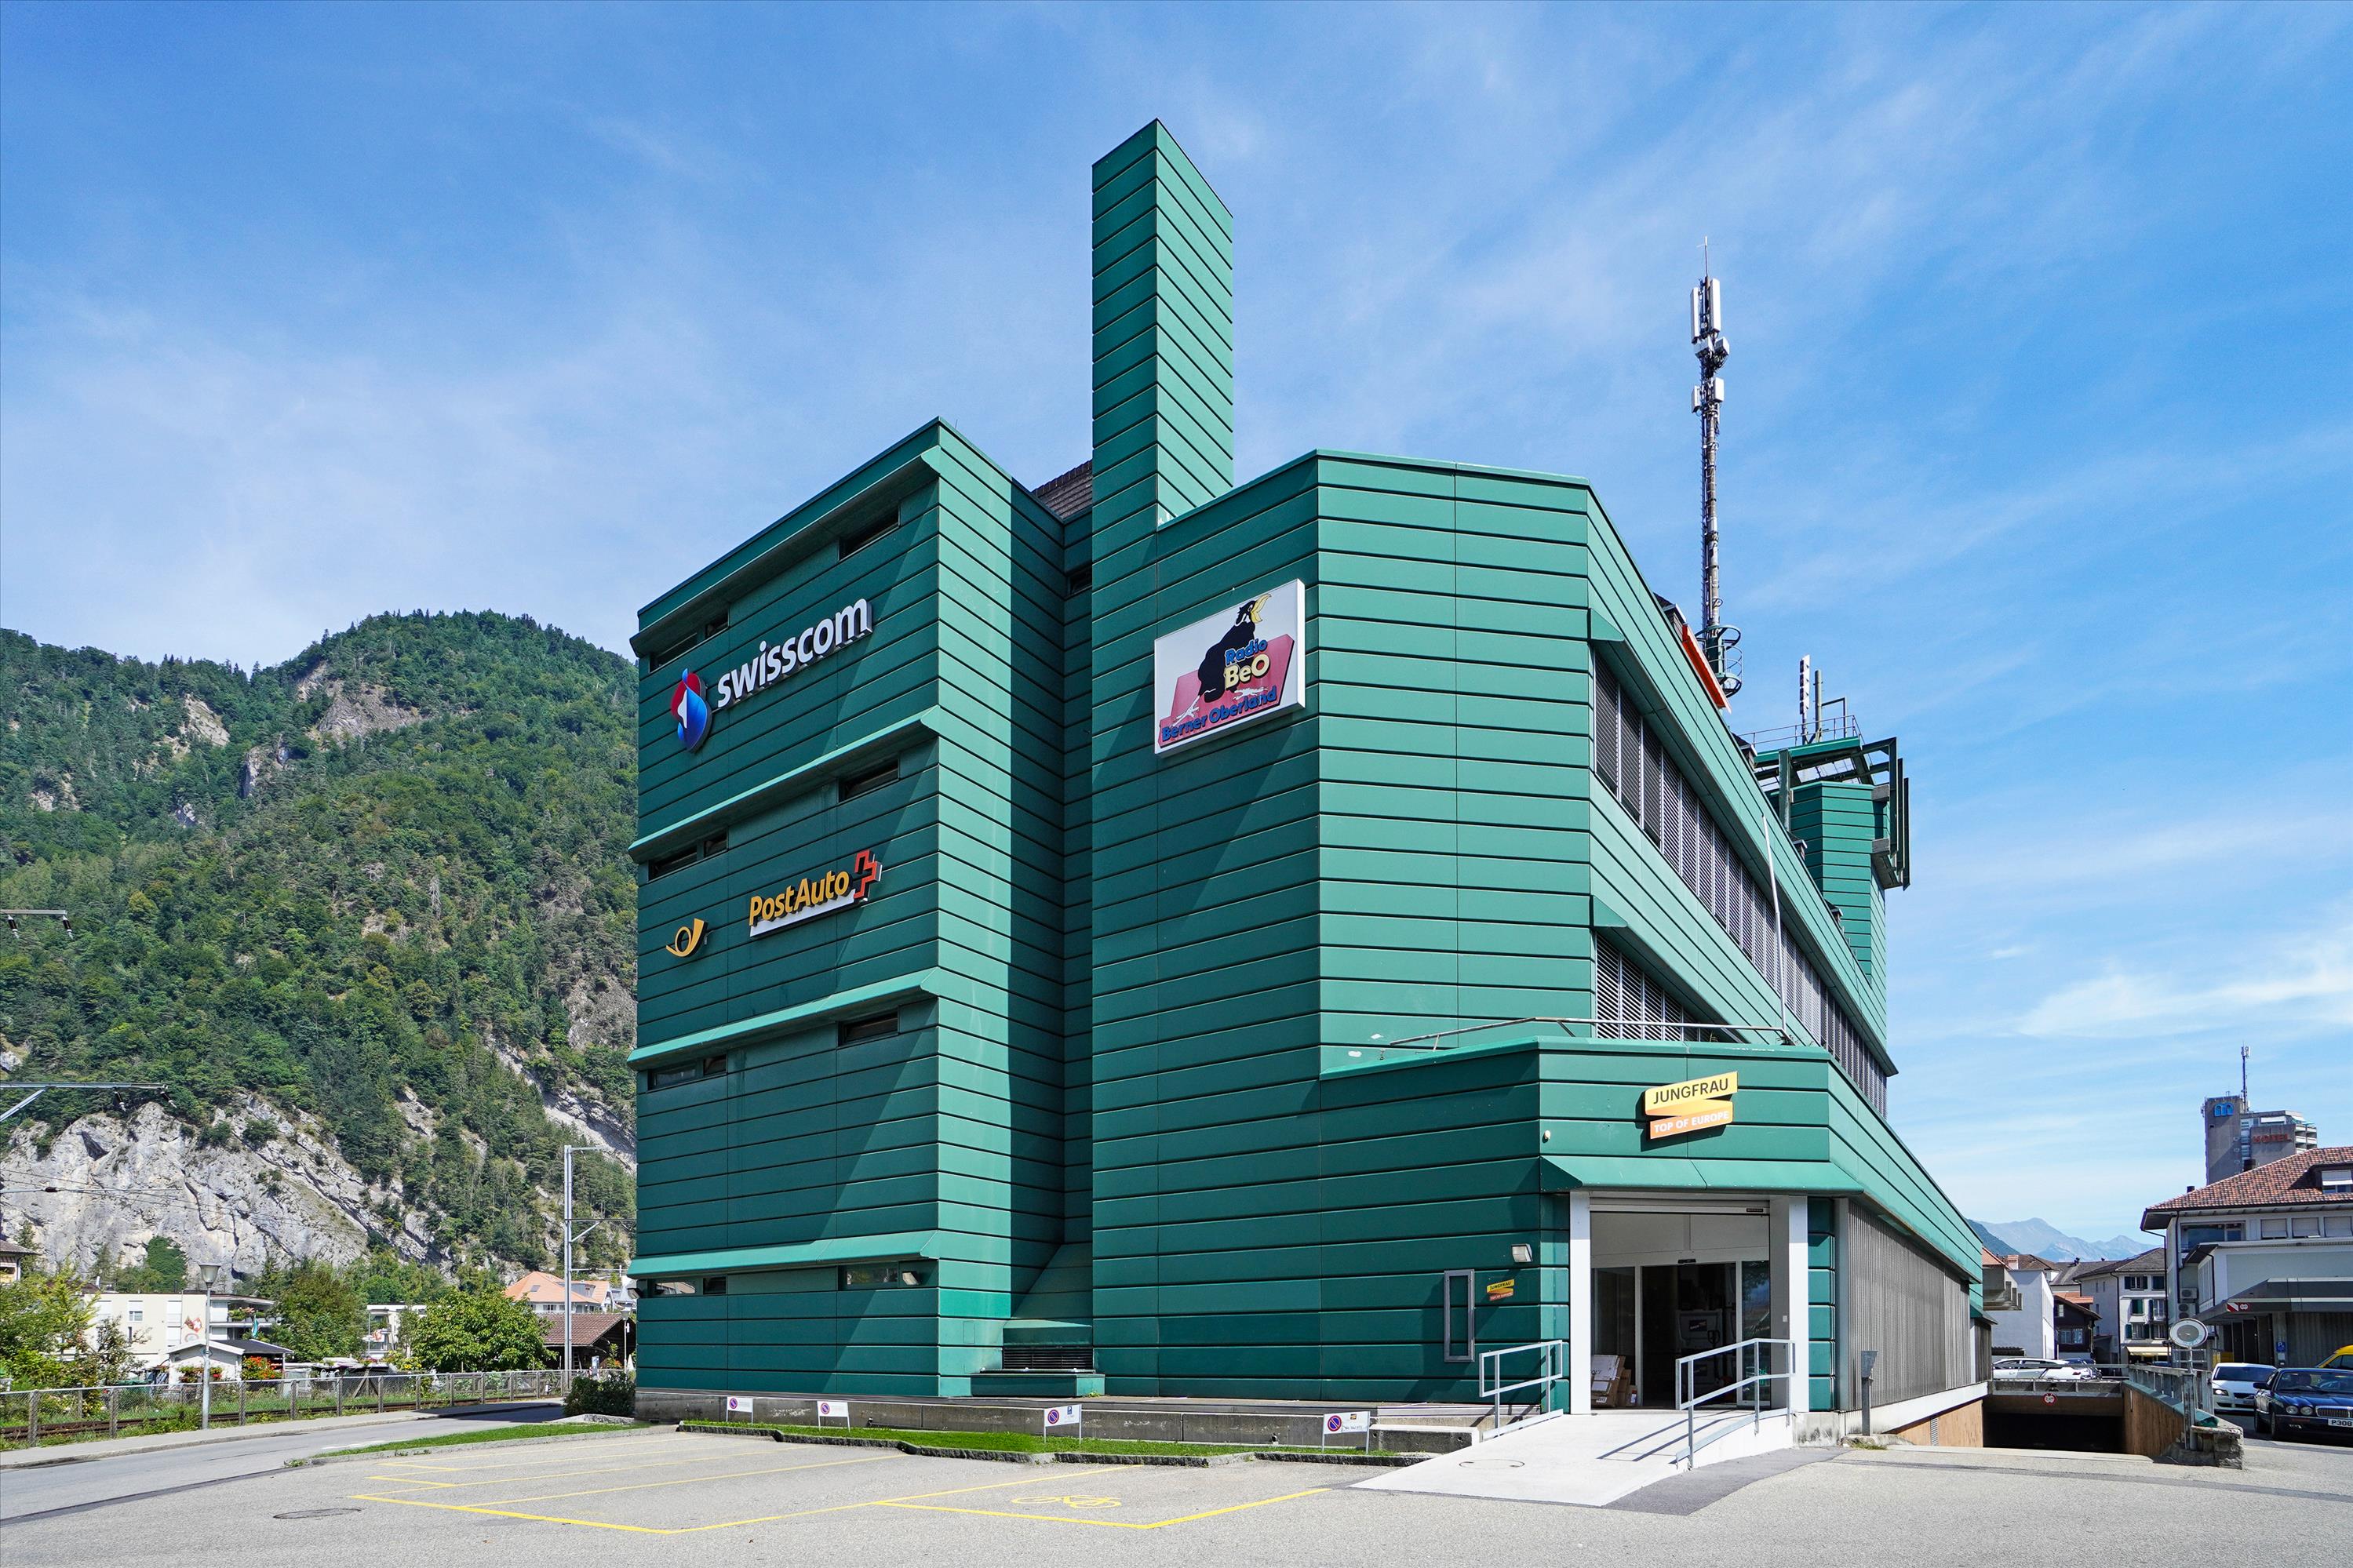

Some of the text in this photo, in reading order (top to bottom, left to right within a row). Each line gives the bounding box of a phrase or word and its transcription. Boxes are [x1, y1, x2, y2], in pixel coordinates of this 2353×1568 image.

[717, 598, 872, 708] swisscom
[1225, 638, 1267, 664] Radio
[1225, 653, 1270, 689] BeO
[1161, 686, 1277, 741] Berner Oberland
[749, 871, 850, 926] PostAuto
[1653, 1078, 1728, 1104] JUNGFRAU
[1654, 1111, 1729, 1133] TOP OF EUROPE
[2253, 1133, 2291, 1143] HOTEL
